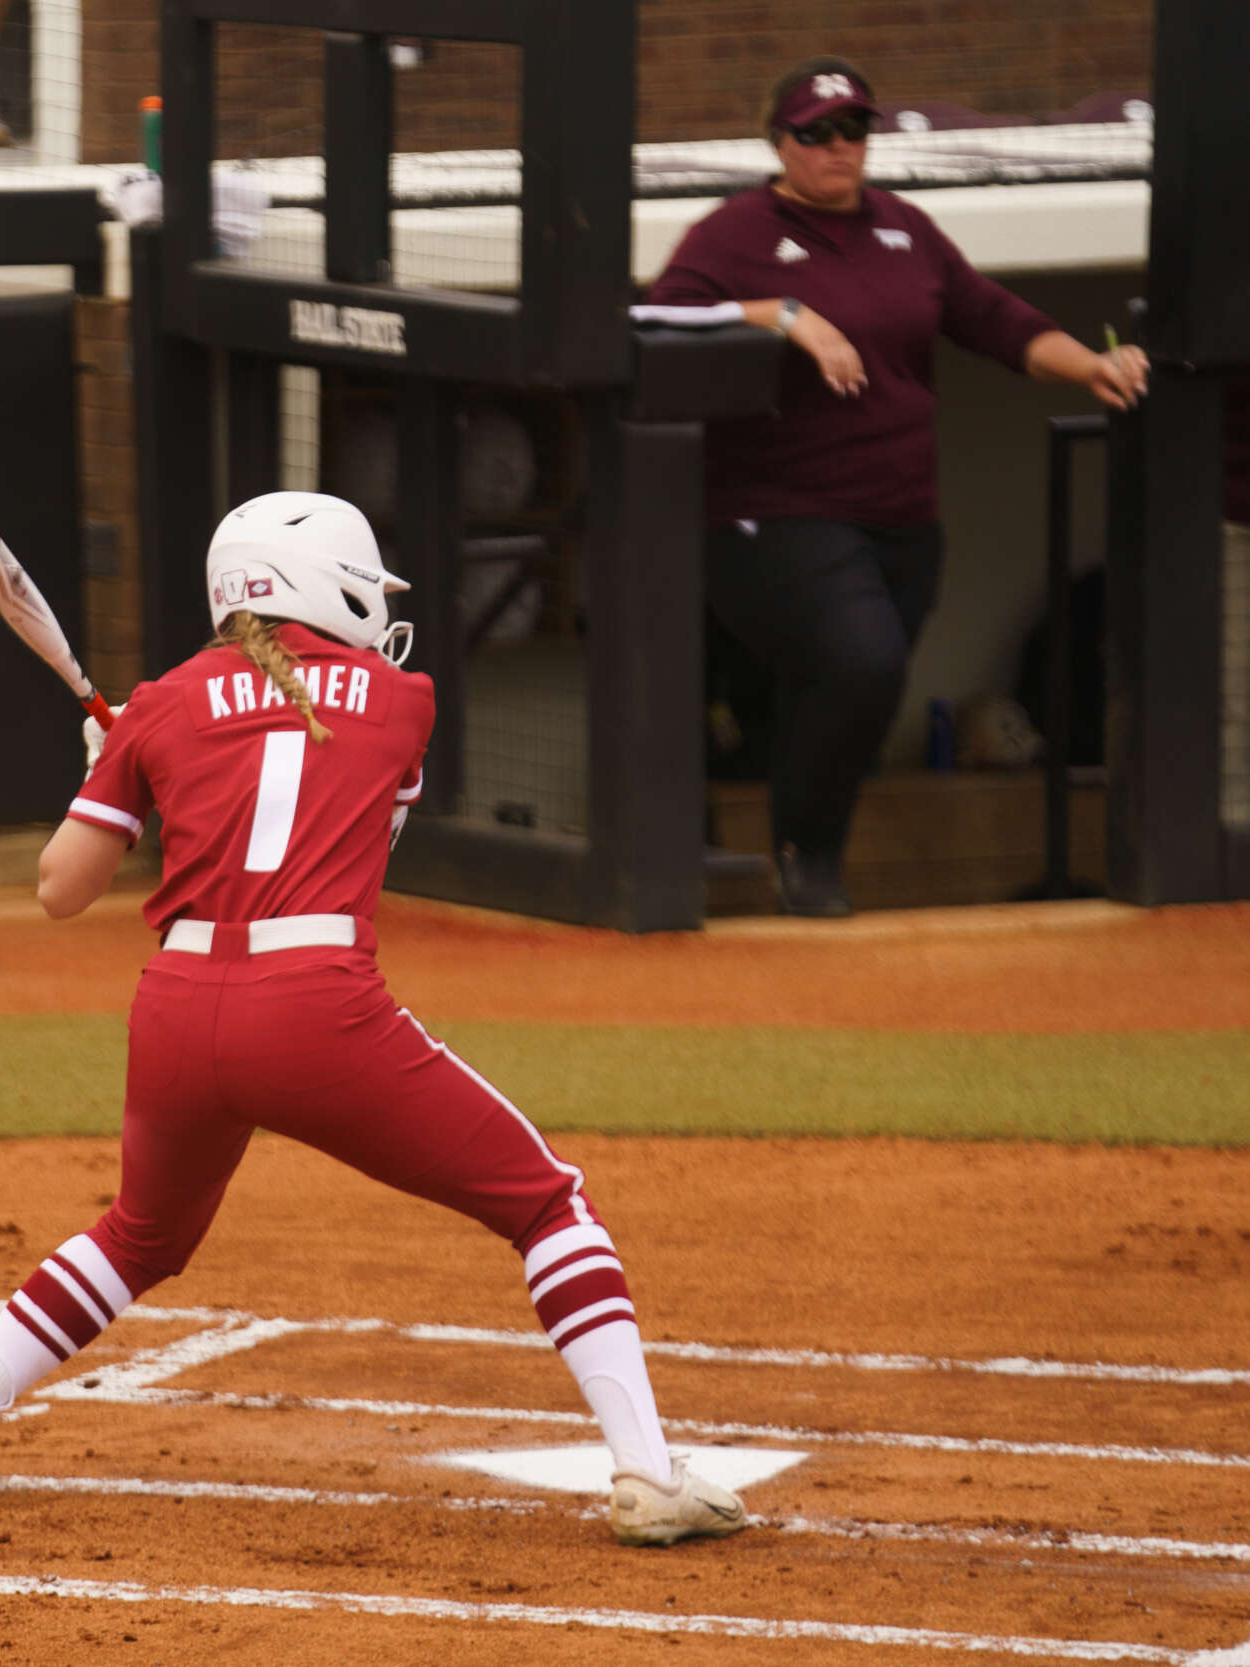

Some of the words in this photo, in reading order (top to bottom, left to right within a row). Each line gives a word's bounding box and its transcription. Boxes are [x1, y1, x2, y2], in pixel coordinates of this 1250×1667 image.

[340, 305, 407, 354] STATE
[206, 664, 371, 720] KRAMER
[244, 730, 307, 872] 1
